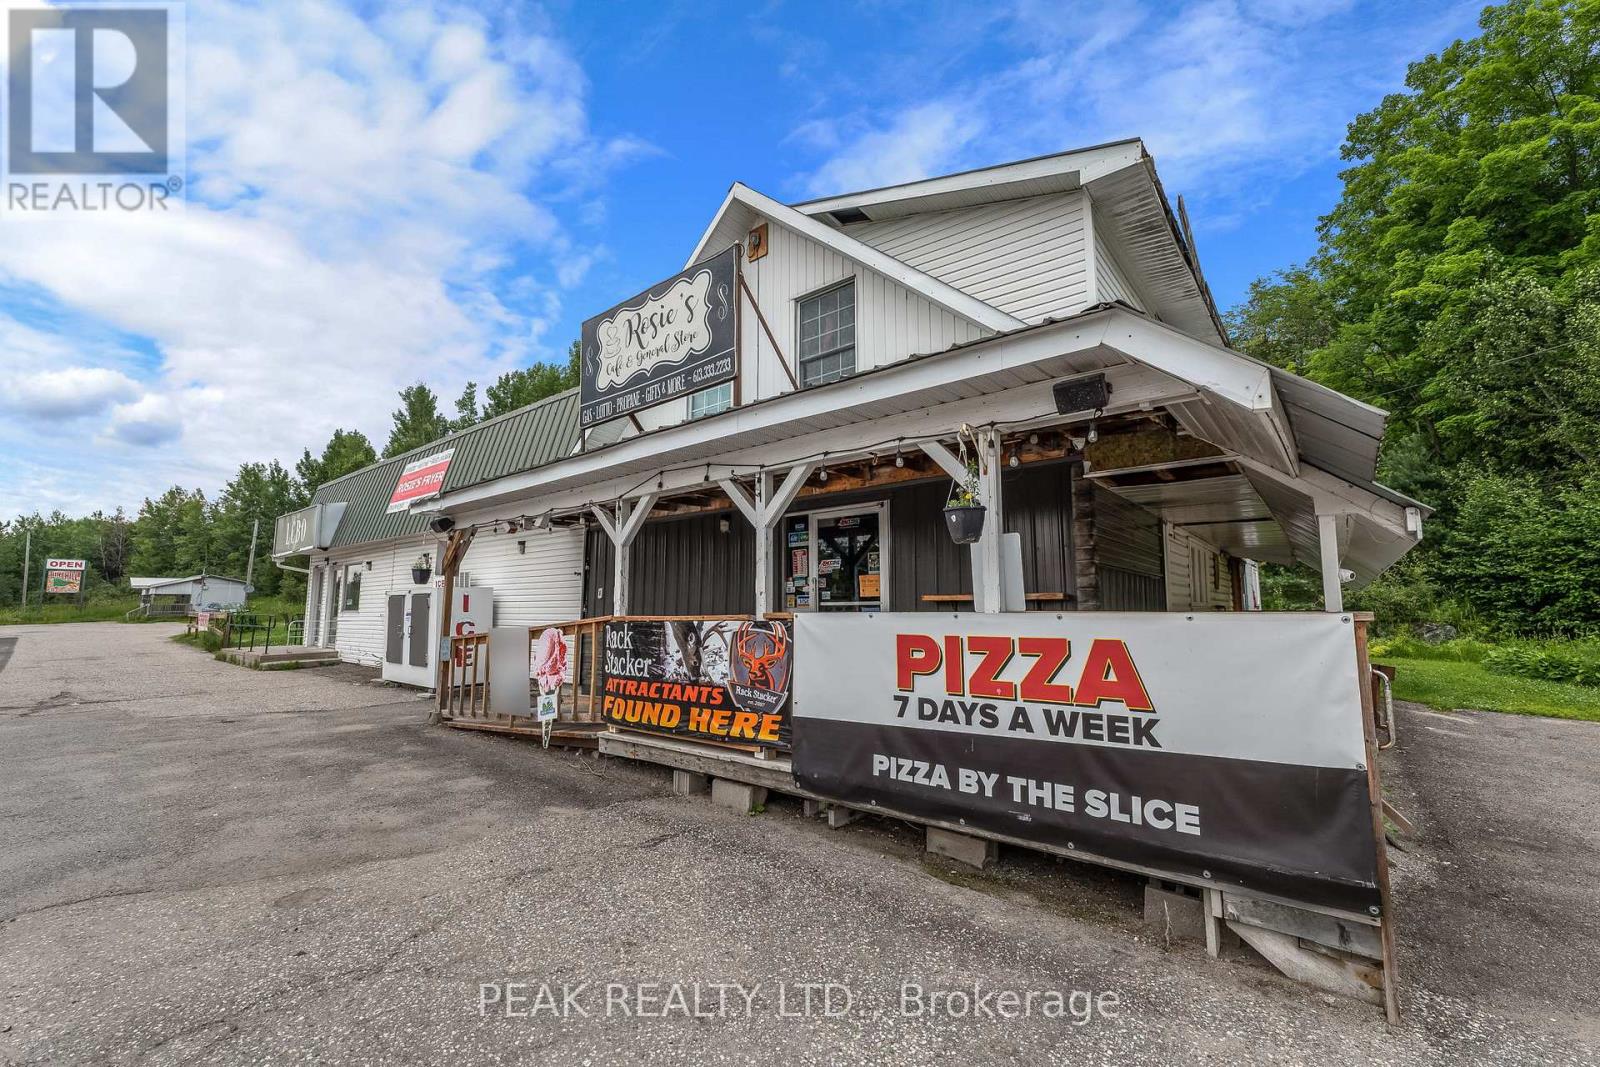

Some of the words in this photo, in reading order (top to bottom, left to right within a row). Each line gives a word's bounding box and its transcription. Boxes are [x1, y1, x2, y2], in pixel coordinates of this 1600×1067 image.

[636, 333, 669, 366] General
[671, 330, 698, 352] Store
[582, 408, 593, 424] GAS
[596, 401, 613, 420] LOTTO
[616, 391, 642, 412] PROPANE
[645, 383, 661, 402] GIFTS
[667, 374, 686, 394] MORE
[435, 580, 445, 588] ICE
[605, 623, 633, 650] Rack
[605, 651, 651, 678] Stacker
[896, 634, 1157, 713] PIZZA
[606, 677, 724, 705] ATTRACTANTS
[735, 685, 752, 698] Rack
[753, 689, 778, 704] Stacker
[603, 695, 681, 728] FOUND
[688, 707, 783, 741] HERE
[893, 695, 910, 718] 7
[917, 697, 999, 729] DAYS
[1007, 706, 1034, 733] A
[1042, 708, 1163, 748] WEEK
[873, 754, 951, 790] PIZZA
[959, 767, 1000, 797] BY
[1007, 775, 1075, 813] THE
[1084, 790, 1201, 836] SLICE
